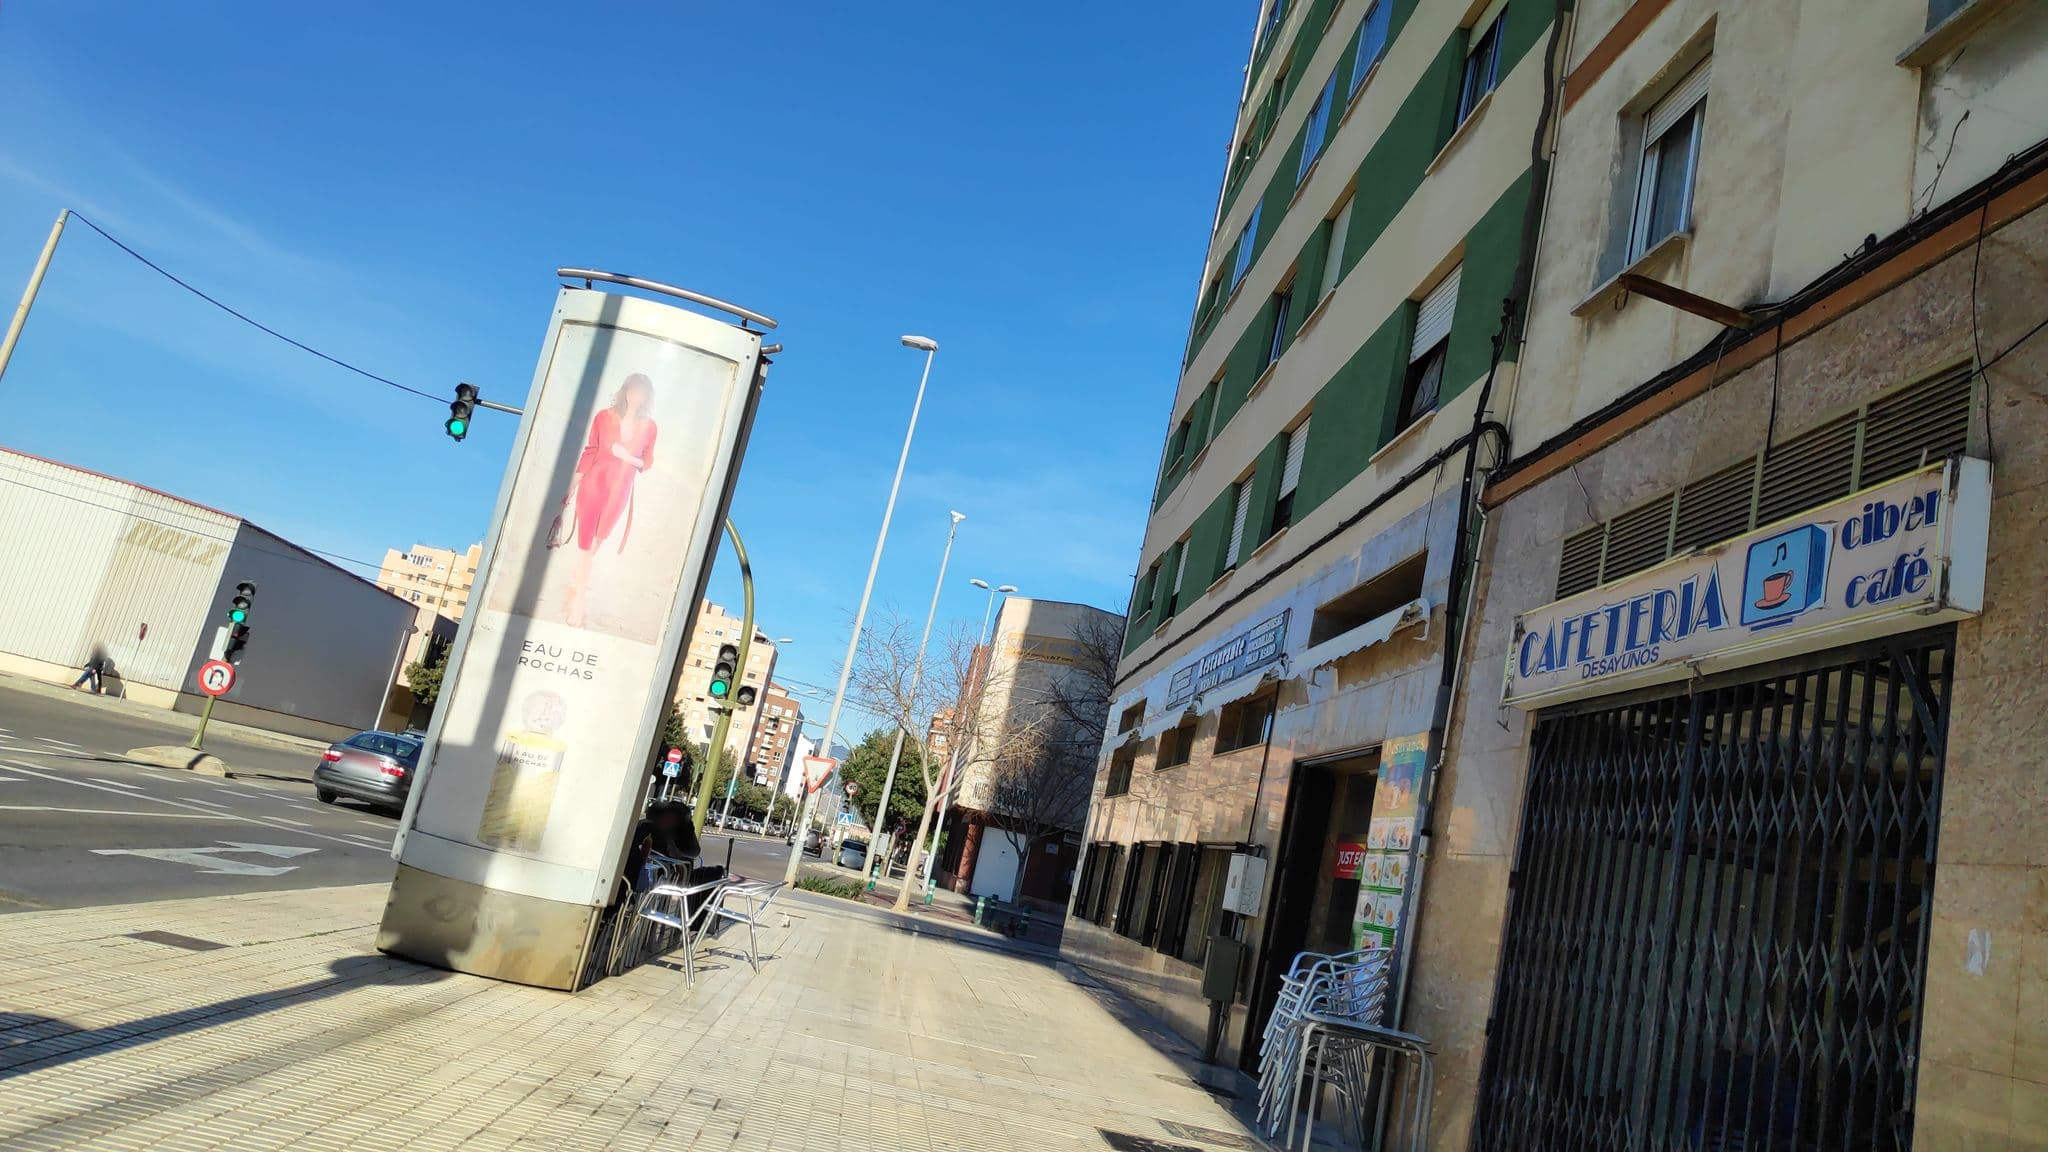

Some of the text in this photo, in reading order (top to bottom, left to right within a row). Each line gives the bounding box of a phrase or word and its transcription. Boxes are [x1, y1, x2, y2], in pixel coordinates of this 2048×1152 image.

[1841, 489, 1943, 550] ciber
[1845, 548, 1932, 610] café
[1519, 561, 1725, 679] CAFETERIA
[521, 640, 599, 667] EAU DE
[1581, 645, 1660, 681] DESAYUNOS
[518, 656, 594, 681] ROCHAS
[512, 757, 548, 768] ROCHAS
[515, 749, 535, 760] EAU
[1337, 850, 1366, 866] JUST EA
